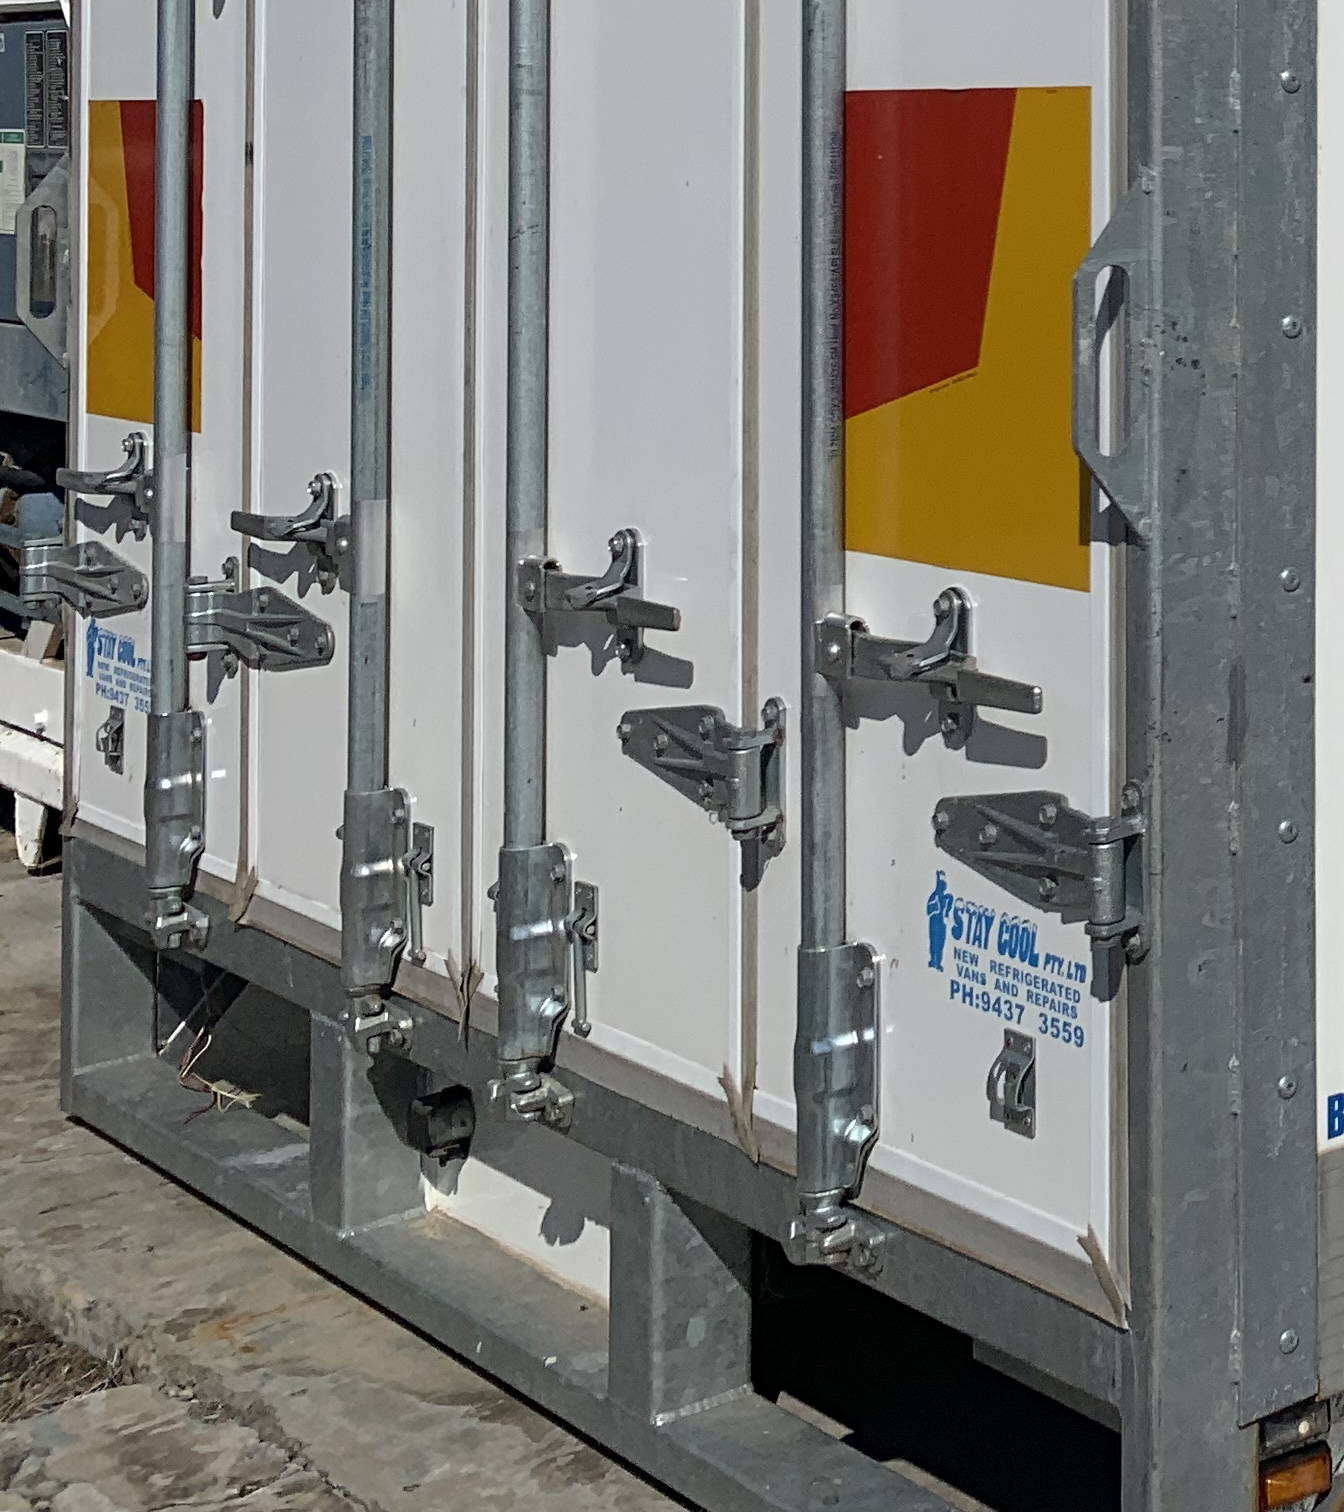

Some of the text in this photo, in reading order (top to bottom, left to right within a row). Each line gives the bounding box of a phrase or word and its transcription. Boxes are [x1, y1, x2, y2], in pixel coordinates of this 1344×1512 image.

[951, 897, 996, 951] STAY
[997, 912, 1040, 968] COOL
[953, 947, 1081, 1004] NEW REFRIGERATED
[956, 964, 1078, 1019] VANS AND REPAIRS
[950, 979, 1085, 1048] PH:9437 3559
